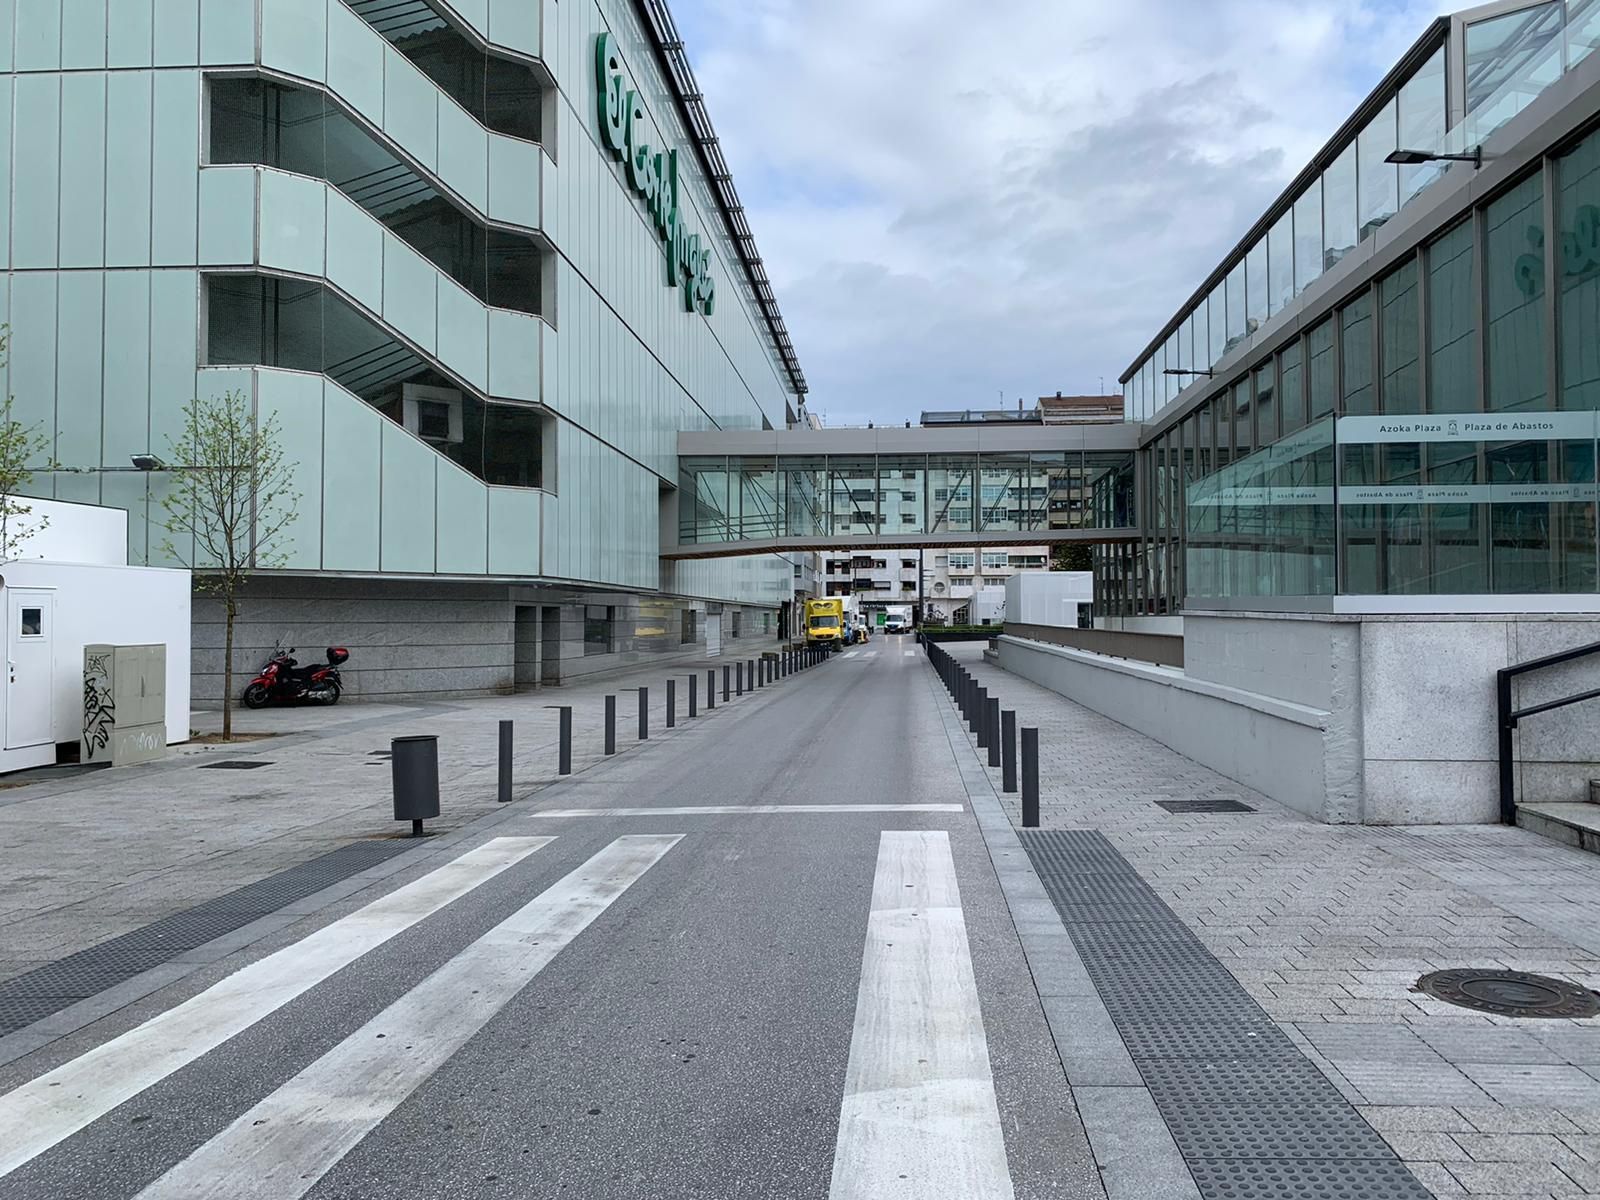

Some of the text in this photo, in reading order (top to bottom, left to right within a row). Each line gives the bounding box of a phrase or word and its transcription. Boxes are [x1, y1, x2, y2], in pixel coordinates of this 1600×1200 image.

[1379, 421, 1555, 433] Azoka Plaza Plaza de Abastos
